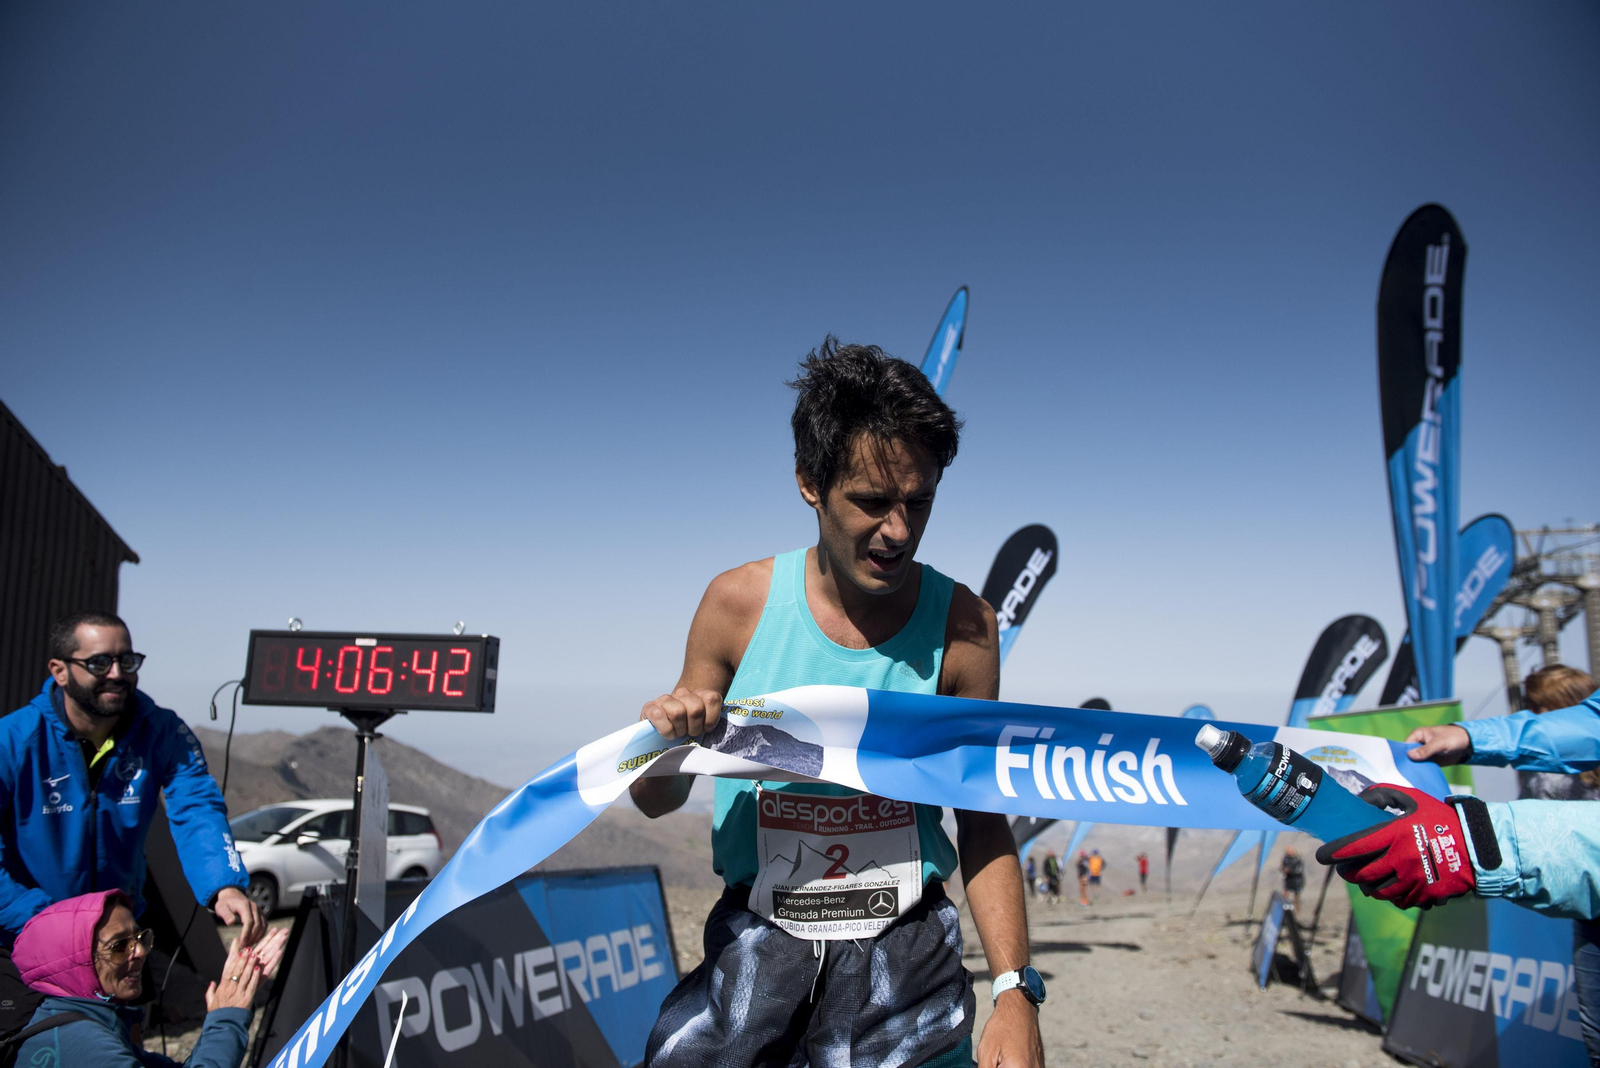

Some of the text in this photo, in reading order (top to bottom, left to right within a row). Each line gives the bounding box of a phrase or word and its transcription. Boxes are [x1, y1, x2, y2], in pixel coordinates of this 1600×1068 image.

[1414, 240, 1450, 610] POWERADE
[297, 646, 471, 697] 4:06:42
[724, 698, 765, 708] ardest
[752, 709, 784, 720] world
[996, 725, 1188, 805] Finish
[762, 794, 909, 831] alssport.es
[793, 822, 813, 830] TIENDA
[818, 825, 849, 833] RUNNING
[880, 816, 910, 828] OUTDOOR
[1412, 824, 1425, 852] FOAM
[822, 844, 850, 880] 2
[772, 884, 790, 892] JUAN
[777, 895, 846, 906] Mercedes-Benz
[778, 907, 865, 920] Granada Premium
[780, 920, 806, 933] SUBIDA
[808, 921, 862, 933] GRANADA-PICO
[864, 919, 890, 932] VELETA
[376, 924, 664, 1066] POWERADE
[1410, 942, 1586, 1042] POWERADE
